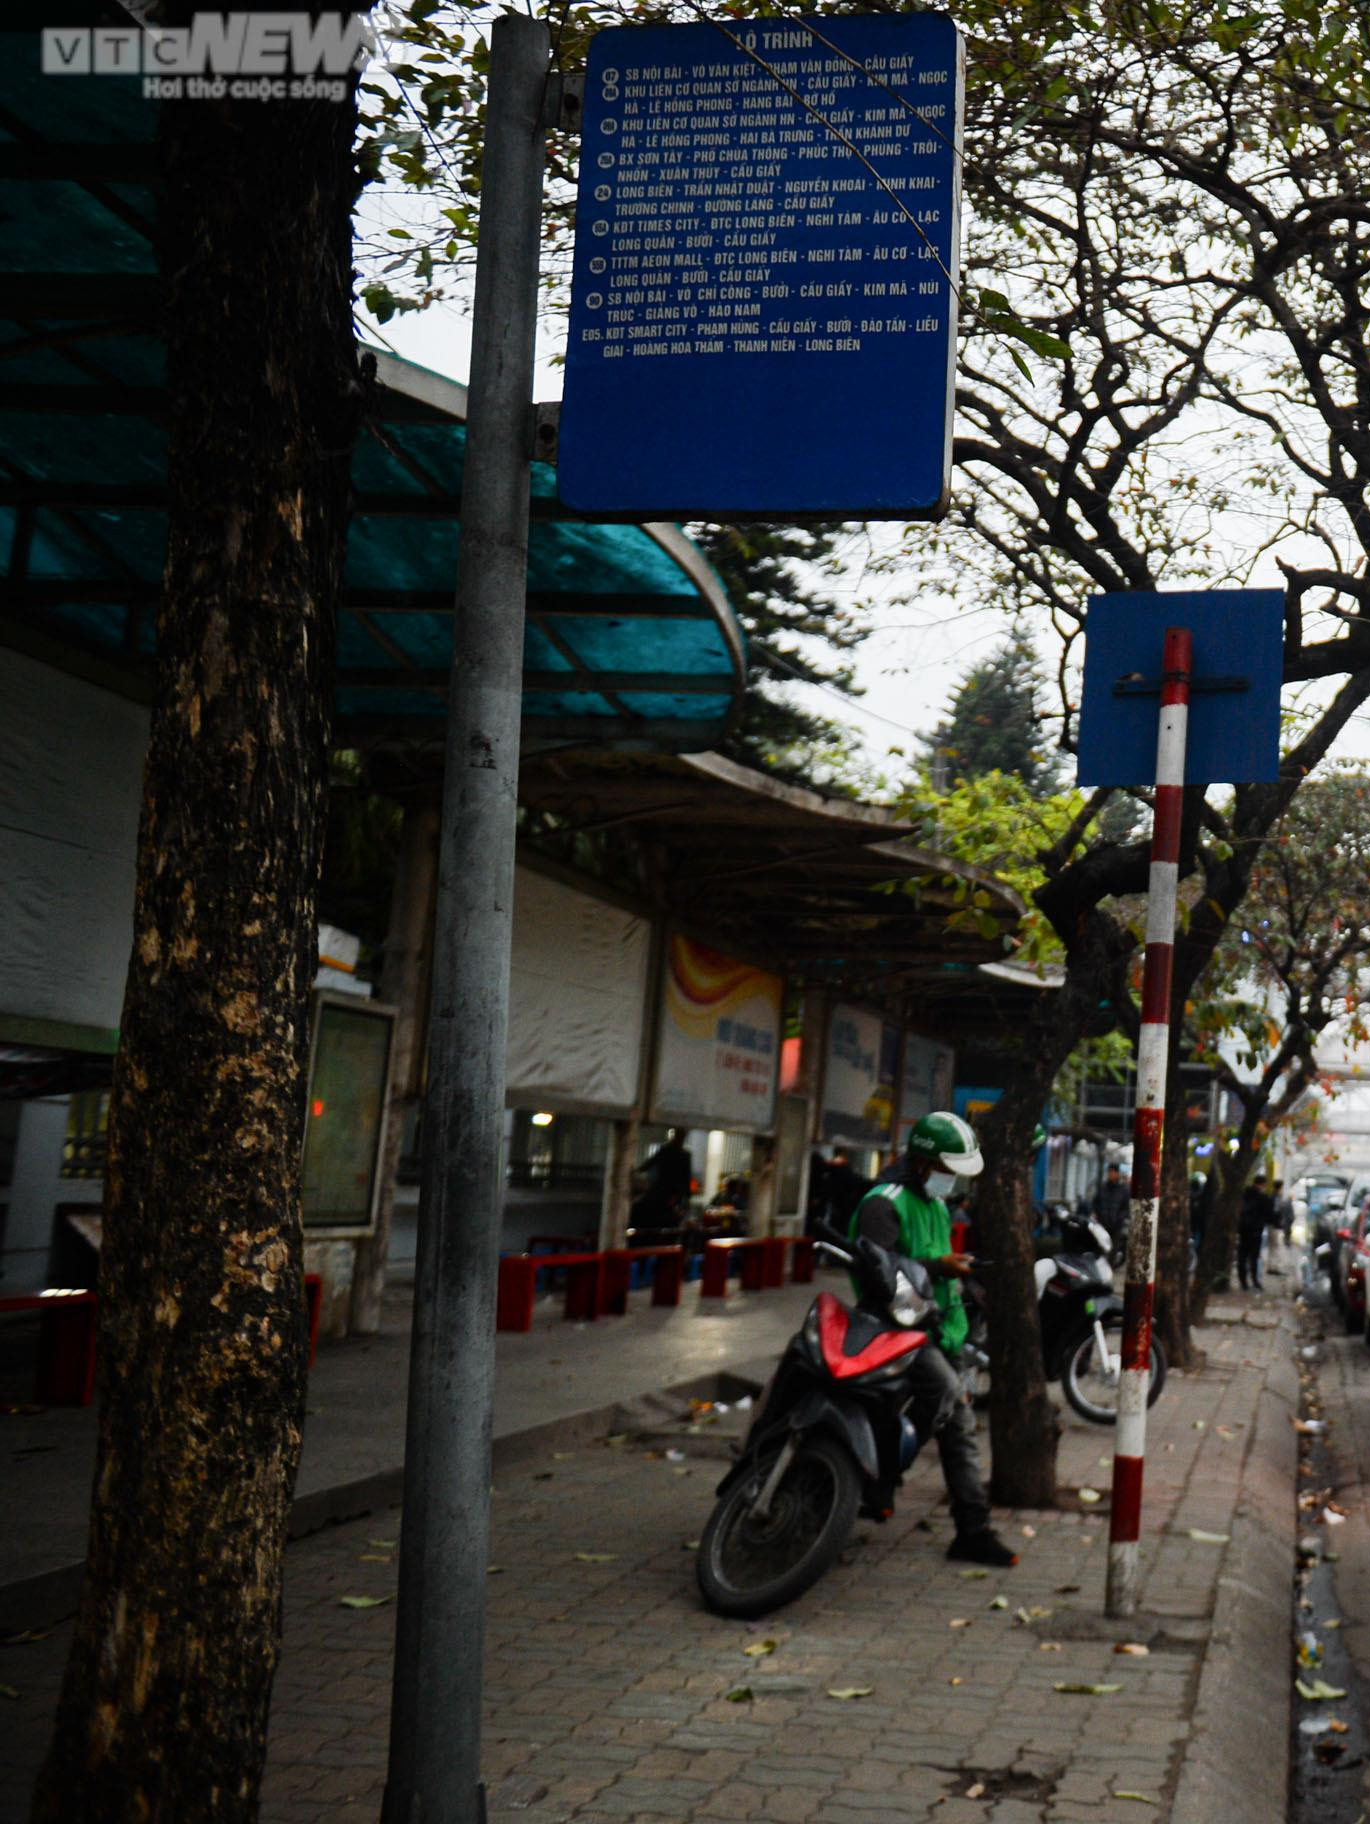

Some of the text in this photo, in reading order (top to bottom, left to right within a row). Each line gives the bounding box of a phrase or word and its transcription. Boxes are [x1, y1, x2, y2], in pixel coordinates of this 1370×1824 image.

[763, 27, 812, 48] TRÌNH
[626, 69, 639, 81] SB
[643, 65, 660, 81] NỘI
[665, 65, 681, 79] BÀI
[625, 85, 645, 98] KHU
[693, 82, 721, 96] QUAN
[919, 71, 948, 85] NGỌC
[696, 98, 732, 111] PHONG
[622, 119, 643, 131] KHU
[691, 115, 719, 130] QUAN
[780, 112, 794, 125] HN
[865, 109, 885, 121] KIM
[693, 132, 729, 145] PHONG
[740, 132, 758, 144] HAI
[896, 123, 911, 137] DƯ
[620, 153, 633, 165] BX
[638, 151, 659, 164] SƠN
[617, 187, 644, 198] LONG
[909, 177, 935, 189] KHAI
[661, 202, 694, 214] CHINH
[613, 222, 634, 233] KĐT
[638, 220, 672, 232] TIMES
[675, 218, 700, 230] CITY
[711, 218, 731, 229] ĐTC
[736, 216, 765, 228] LONG
[806, 214, 833, 226] NGHI
[919, 210, 940, 225] LẠC
[612, 239, 640, 251] LONG
[612, 257, 638, 269] TTTM
[642, 255, 669, 268] AEON
[674, 254, 703, 266] MALL
[714, 253, 735, 264] ĐTC
[738, 252, 768, 264] LONG
[808, 250, 834, 262] NGHI
[892, 246, 908, 259] CƠ
[611, 275, 638, 288] LONG
[608, 293, 621, 305] SB
[625, 289, 644, 305] NỘI
[648, 288, 666, 302] BÀI
[864, 283, 886, 296] KIM
[735, 304, 761, 315] NAM
[582, 329, 604, 341] E05.
[606, 328, 625, 340] KĐT
[628, 326, 662, 338] SMART
[665, 324, 687, 337] CITY
[603, 345, 624, 358] GIAI
[671, 342, 691, 354] HOA
[734, 340, 768, 352] THANH
[806, 339, 833, 351] LONG
